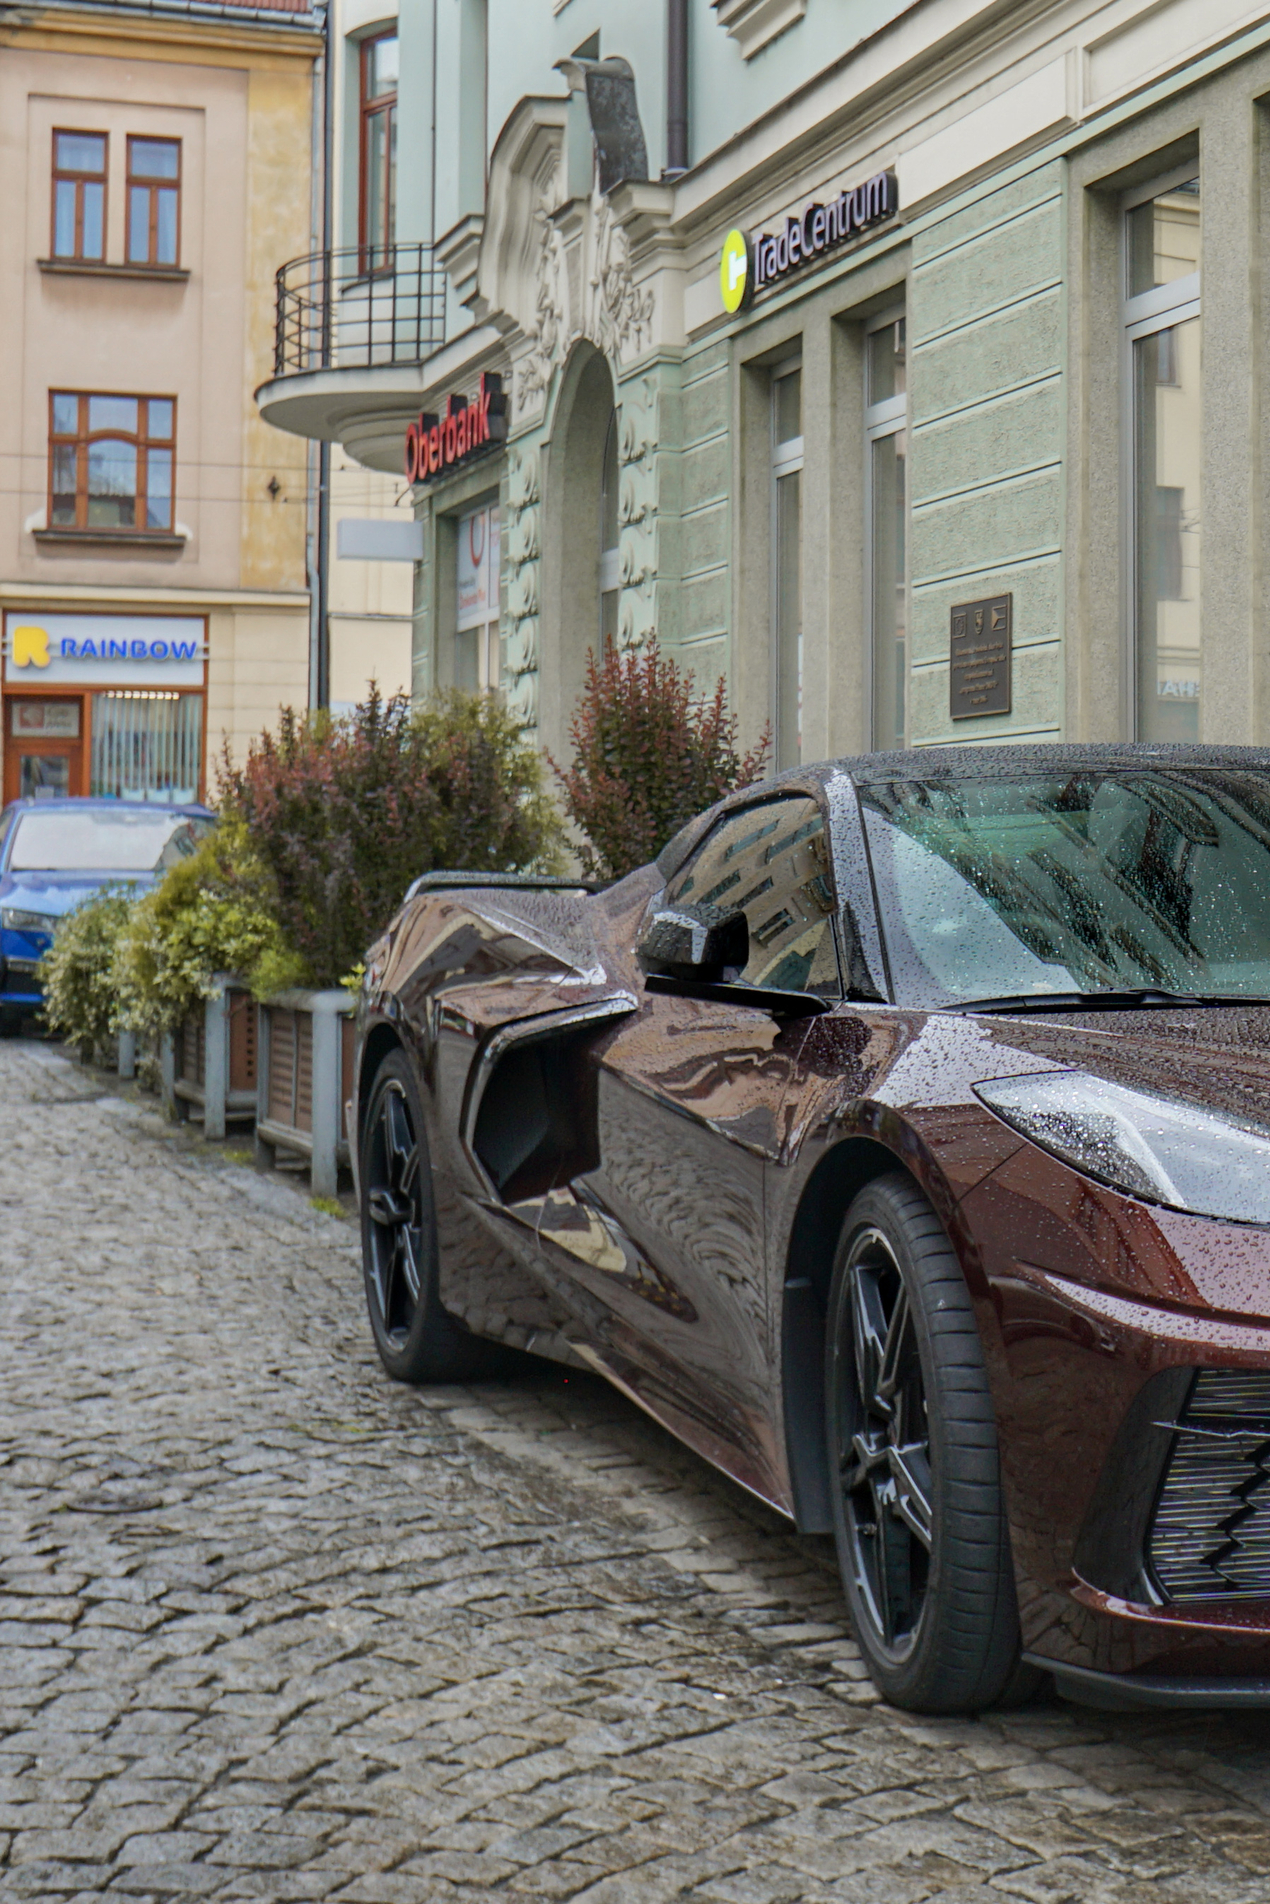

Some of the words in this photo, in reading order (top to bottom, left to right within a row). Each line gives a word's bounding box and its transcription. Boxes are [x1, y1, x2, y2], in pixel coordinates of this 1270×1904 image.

[752, 171, 888, 285] TradeCentrum
[405, 373, 491, 484] Oberbank
[60, 637, 198, 661] RAINBOW
